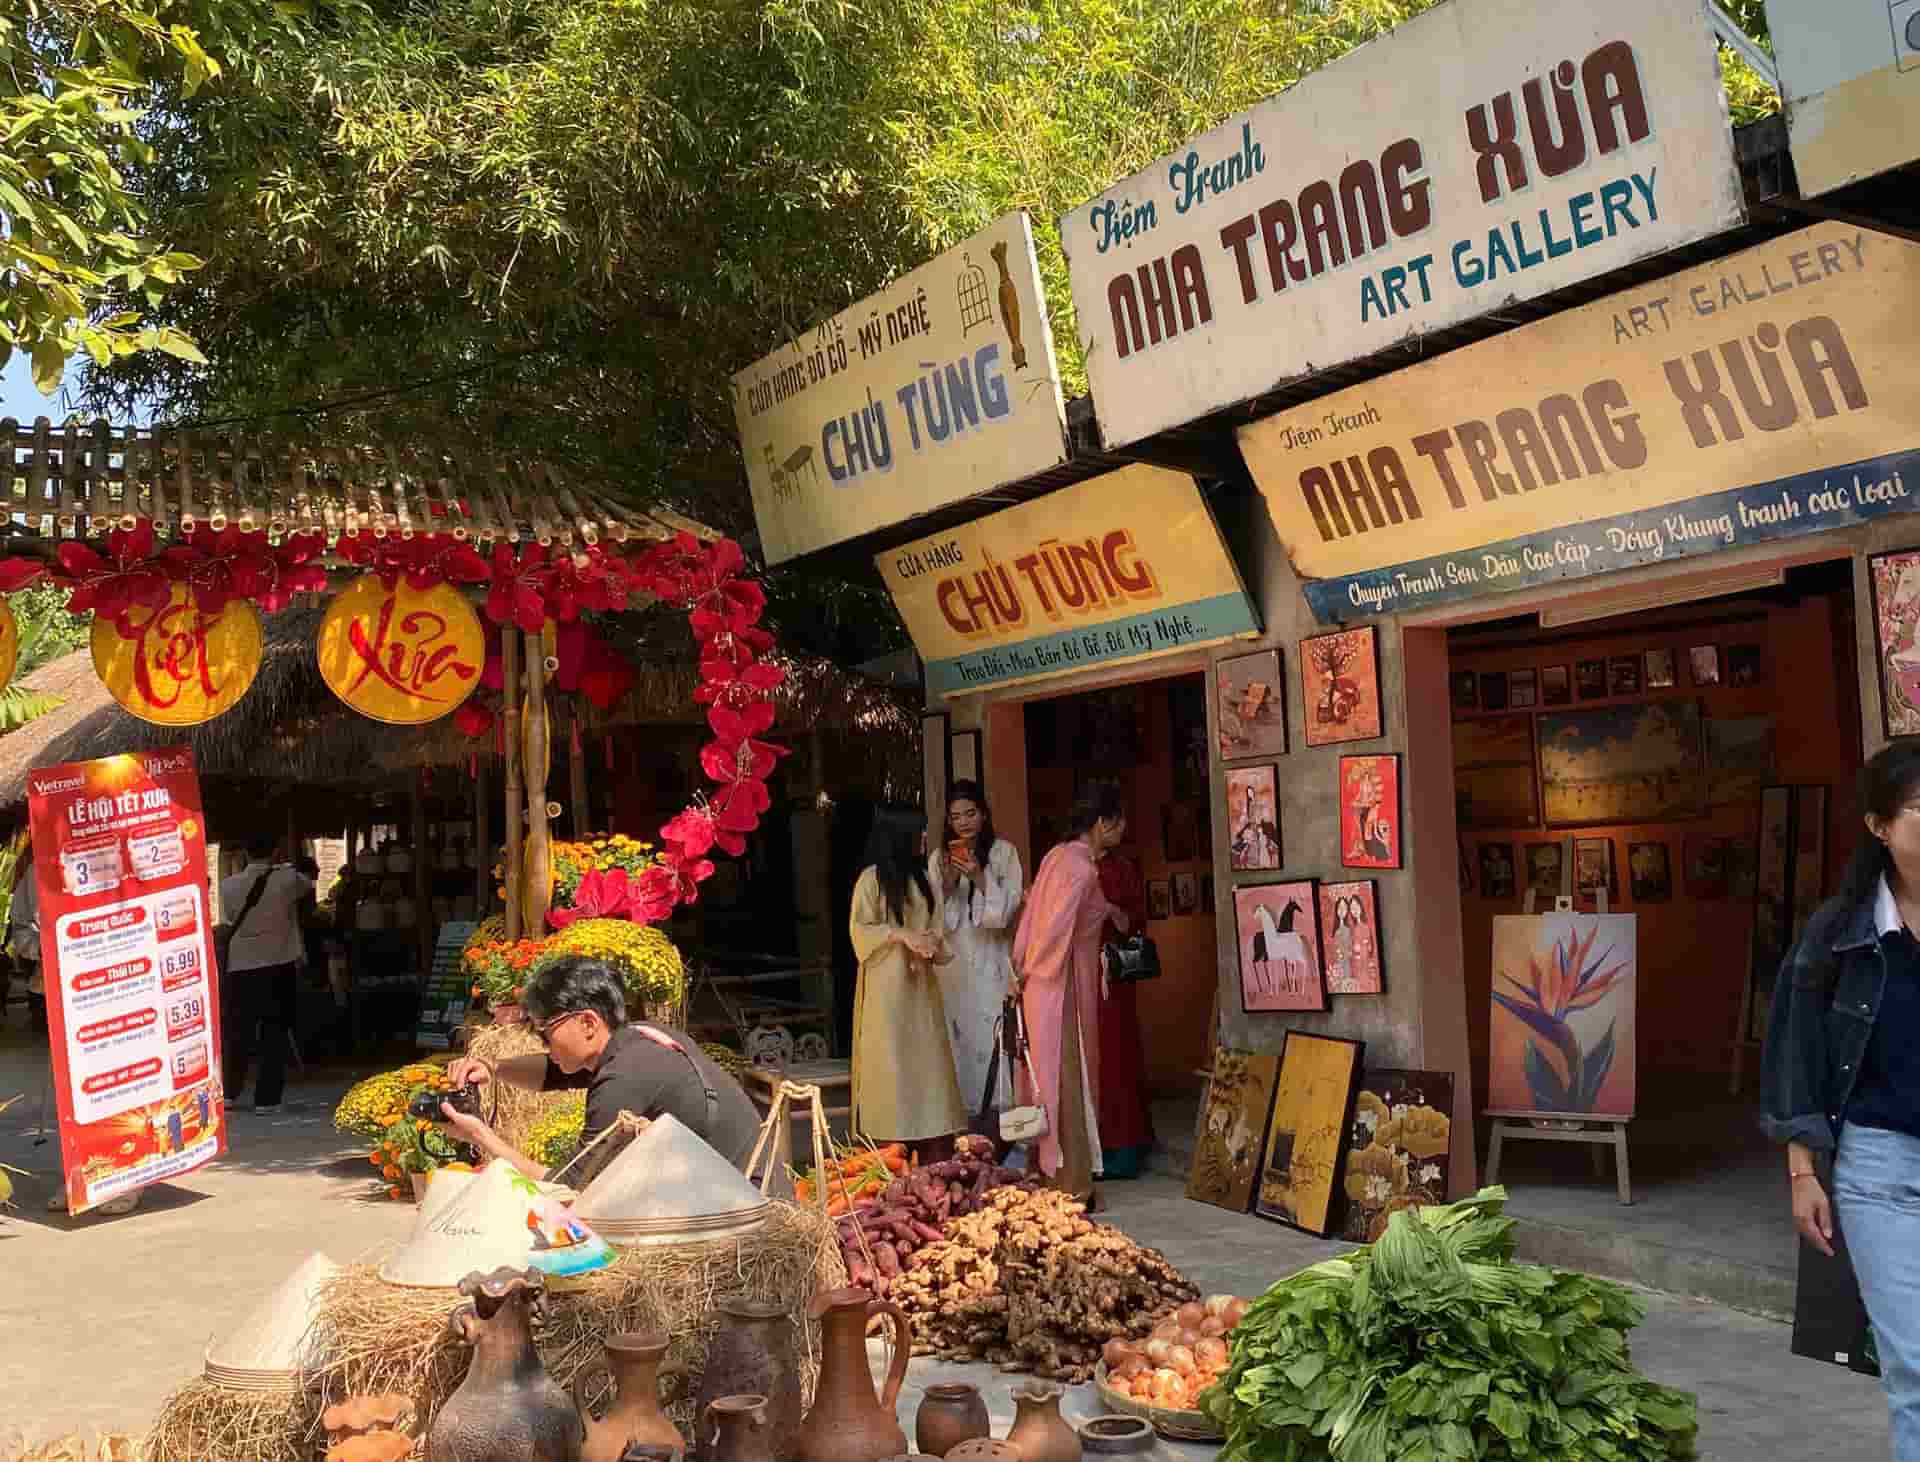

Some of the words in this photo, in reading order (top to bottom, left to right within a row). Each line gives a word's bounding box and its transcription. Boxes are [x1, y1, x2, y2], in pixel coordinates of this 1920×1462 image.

[1090, 198, 1157, 253] Tiệm
[1169, 121, 1265, 214] Tranh
[1107, 243, 1213, 359] NHA
[1220, 138, 1432, 304] TRANG
[1465, 40, 1650, 203] XƯA
[1361, 254, 1433, 323] ART
[1452, 167, 1658, 289] GALLERY
[1612, 297, 1670, 344] ART
[1689, 233, 1865, 317] GALLERY
[858, 311, 882, 360] MỸ
[886, 286, 930, 345] NGHỆ
[822, 386, 892, 481] CHÚ
[896, 343, 1010, 450] TÙNG
[1279, 427, 1323, 451] Tiệm
[1323, 401, 1382, 437] Tranh
[1299, 446, 1424, 542] NHA
[1411, 379, 1648, 510] TRANG
[1663, 315, 1870, 449] XƯA
[927, 540, 963, 571] HÀNG
[1348, 581, 1398, 611] Chuyên
[1396, 568, 1445, 595] Tranh
[1447, 561, 1479, 585] Sơn
[1523, 547, 1554, 571] Cao
[1663, 513, 1734, 543] Khung
[1738, 492, 1800, 528] tranh
[1808, 480, 1849, 514] các
[1854, 471, 1910, 505] loại
[937, 546, 1022, 634] CHÚ
[1015, 529, 1152, 612] TÙNG
[1035, 643, 1061, 667] Bán
[1127, 623, 1152, 650] Mỹ
[33, 775, 85, 793] Vietravel
[88, 796, 113, 824] HỘI
[116, 789, 139, 816] TẾT
[77, 862, 88, 885] 3
[151, 846, 160, 863] 2
[161, 910, 170, 927] 3
[165, 950, 195, 974] 6.99
[171, 1000, 200, 1023] 5.39
[177, 1057, 185, 1074] 5
